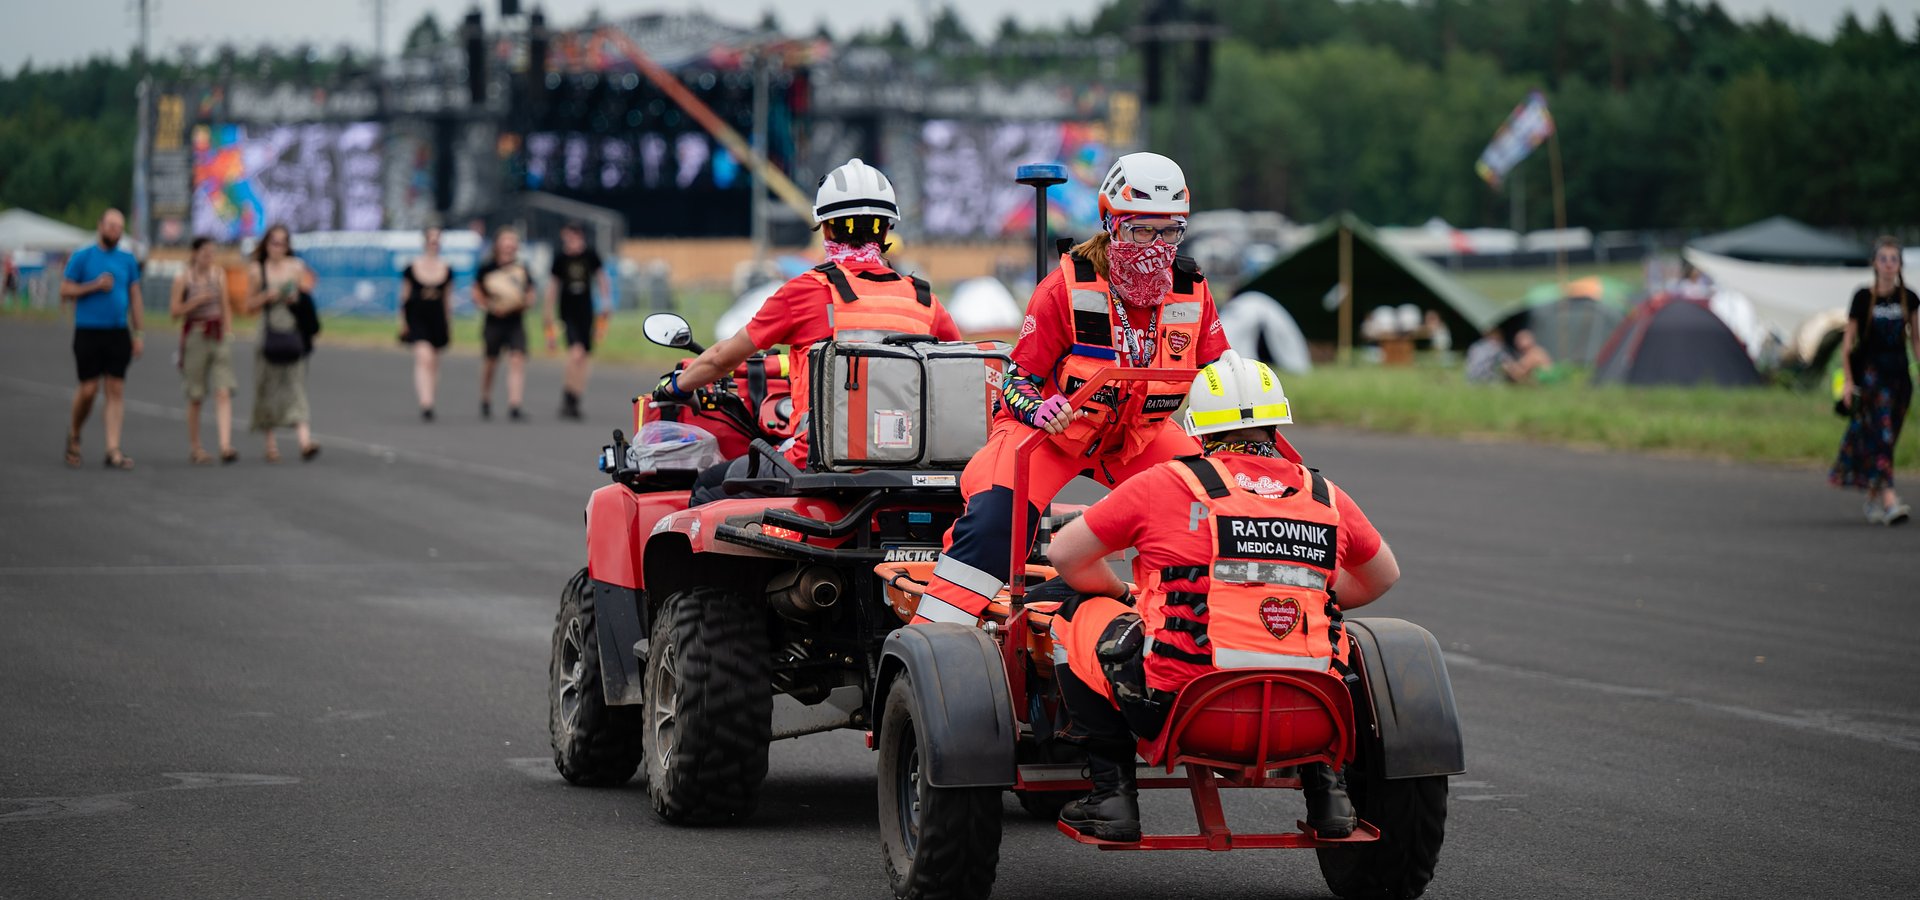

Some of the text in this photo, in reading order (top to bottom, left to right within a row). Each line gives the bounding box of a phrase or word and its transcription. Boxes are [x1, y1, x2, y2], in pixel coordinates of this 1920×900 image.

[1145, 398, 1182, 409] RATOWNIK
[1231, 520, 1328, 546] RATOWNIK
[883, 549, 935, 562] ARCTIC
[1236, 541, 1326, 562] MEDICAL STAFF
